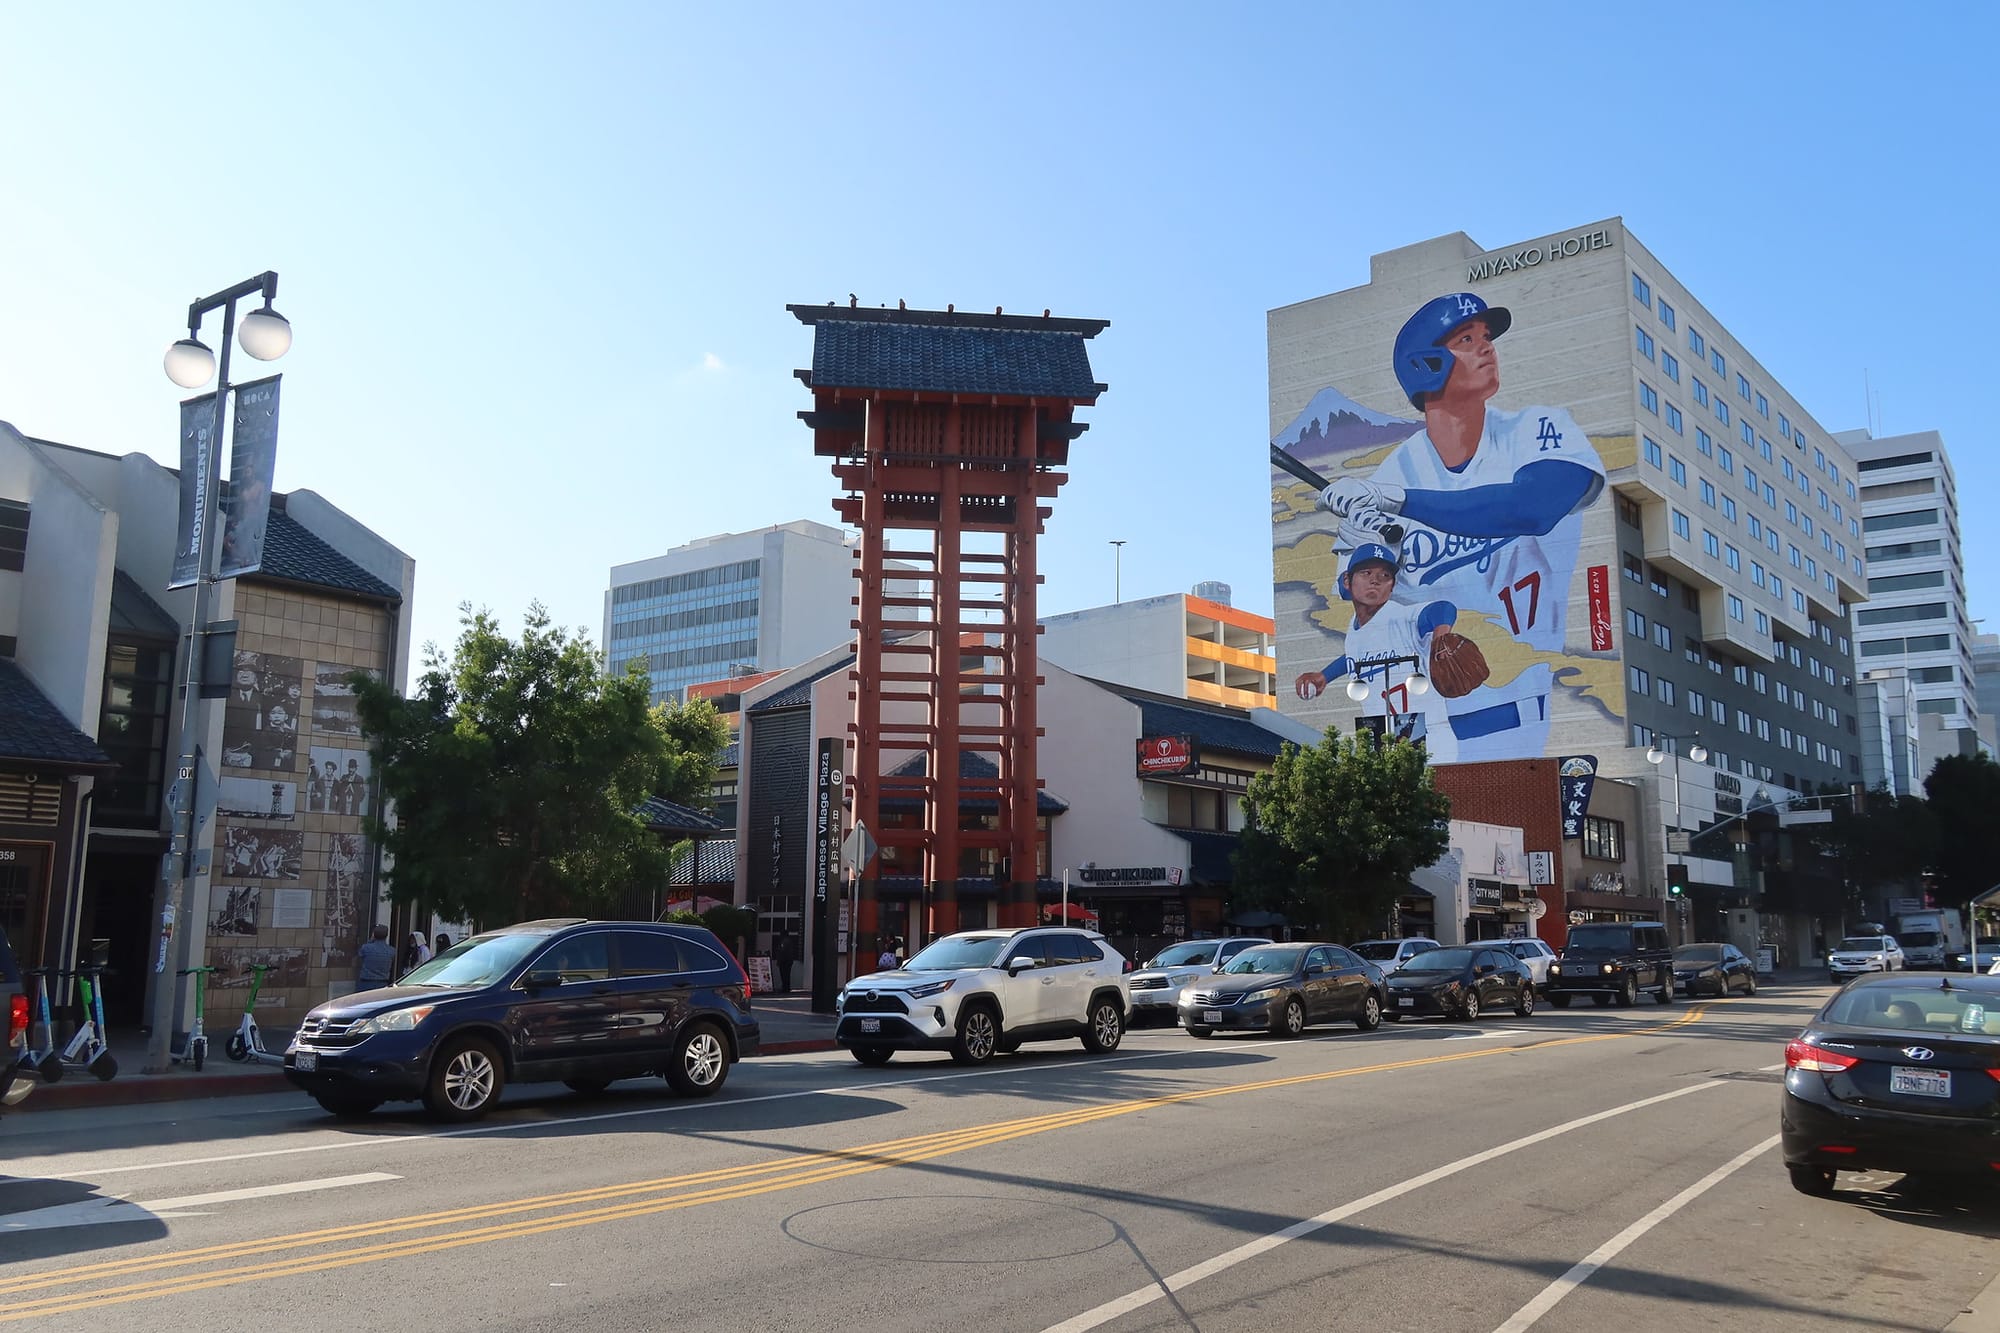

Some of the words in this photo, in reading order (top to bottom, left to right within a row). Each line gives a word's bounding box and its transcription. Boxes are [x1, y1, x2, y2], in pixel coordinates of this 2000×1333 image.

[1467, 247, 1543, 283] MIYAKO
[1549, 229, 1613, 260] HOTEL
[1455, 294, 1477, 316] LA
[1536, 417, 1562, 451] LA
[1498, 570, 1541, 635] 17
[820, 752, 829, 786] Plaza
[818, 792, 829, 834] Village
[1564, 781, 1587, 836] 文化堂
[771, 815, 782, 888] 日本村プラザ
[830, 810, 840, 874] 日本村広場
[816, 839, 827, 902] Japanese
[1080, 867, 1166, 882] CHINCHIKURIN
[1535, 853, 1545, 883] おみやげ
[1488, 890, 1500, 900] HAIR
[1895, 1076, 1946, 1093] 7BNF778
